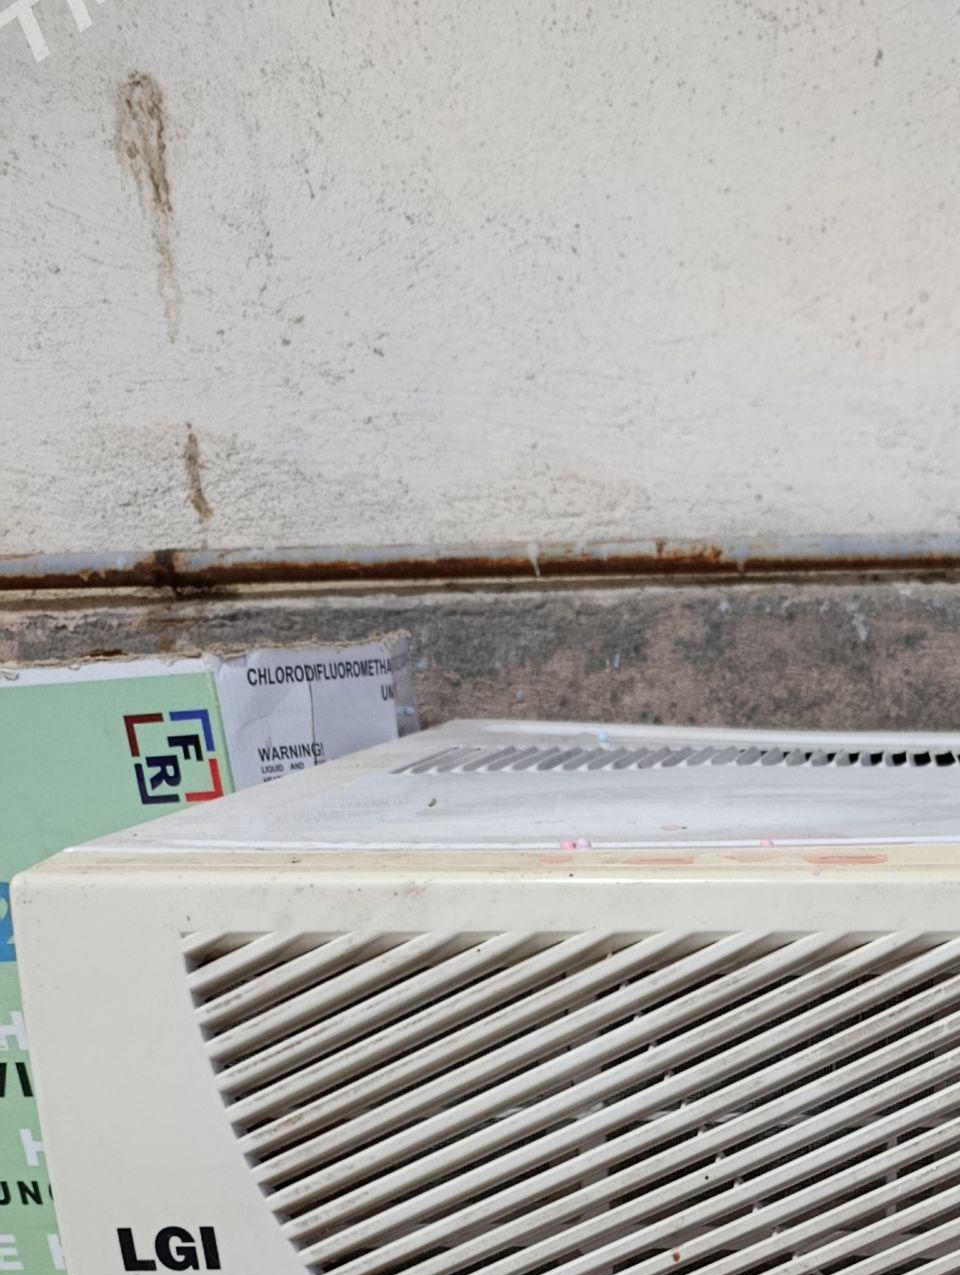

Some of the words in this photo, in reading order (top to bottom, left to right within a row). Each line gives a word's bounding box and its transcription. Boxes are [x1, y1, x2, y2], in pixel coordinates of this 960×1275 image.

[258, 743, 324, 762] WARNING!
[261, 766, 284, 774] LIQUID
[290, 763, 305, 771] AND
[117, 1226, 221, 1271] LGI
